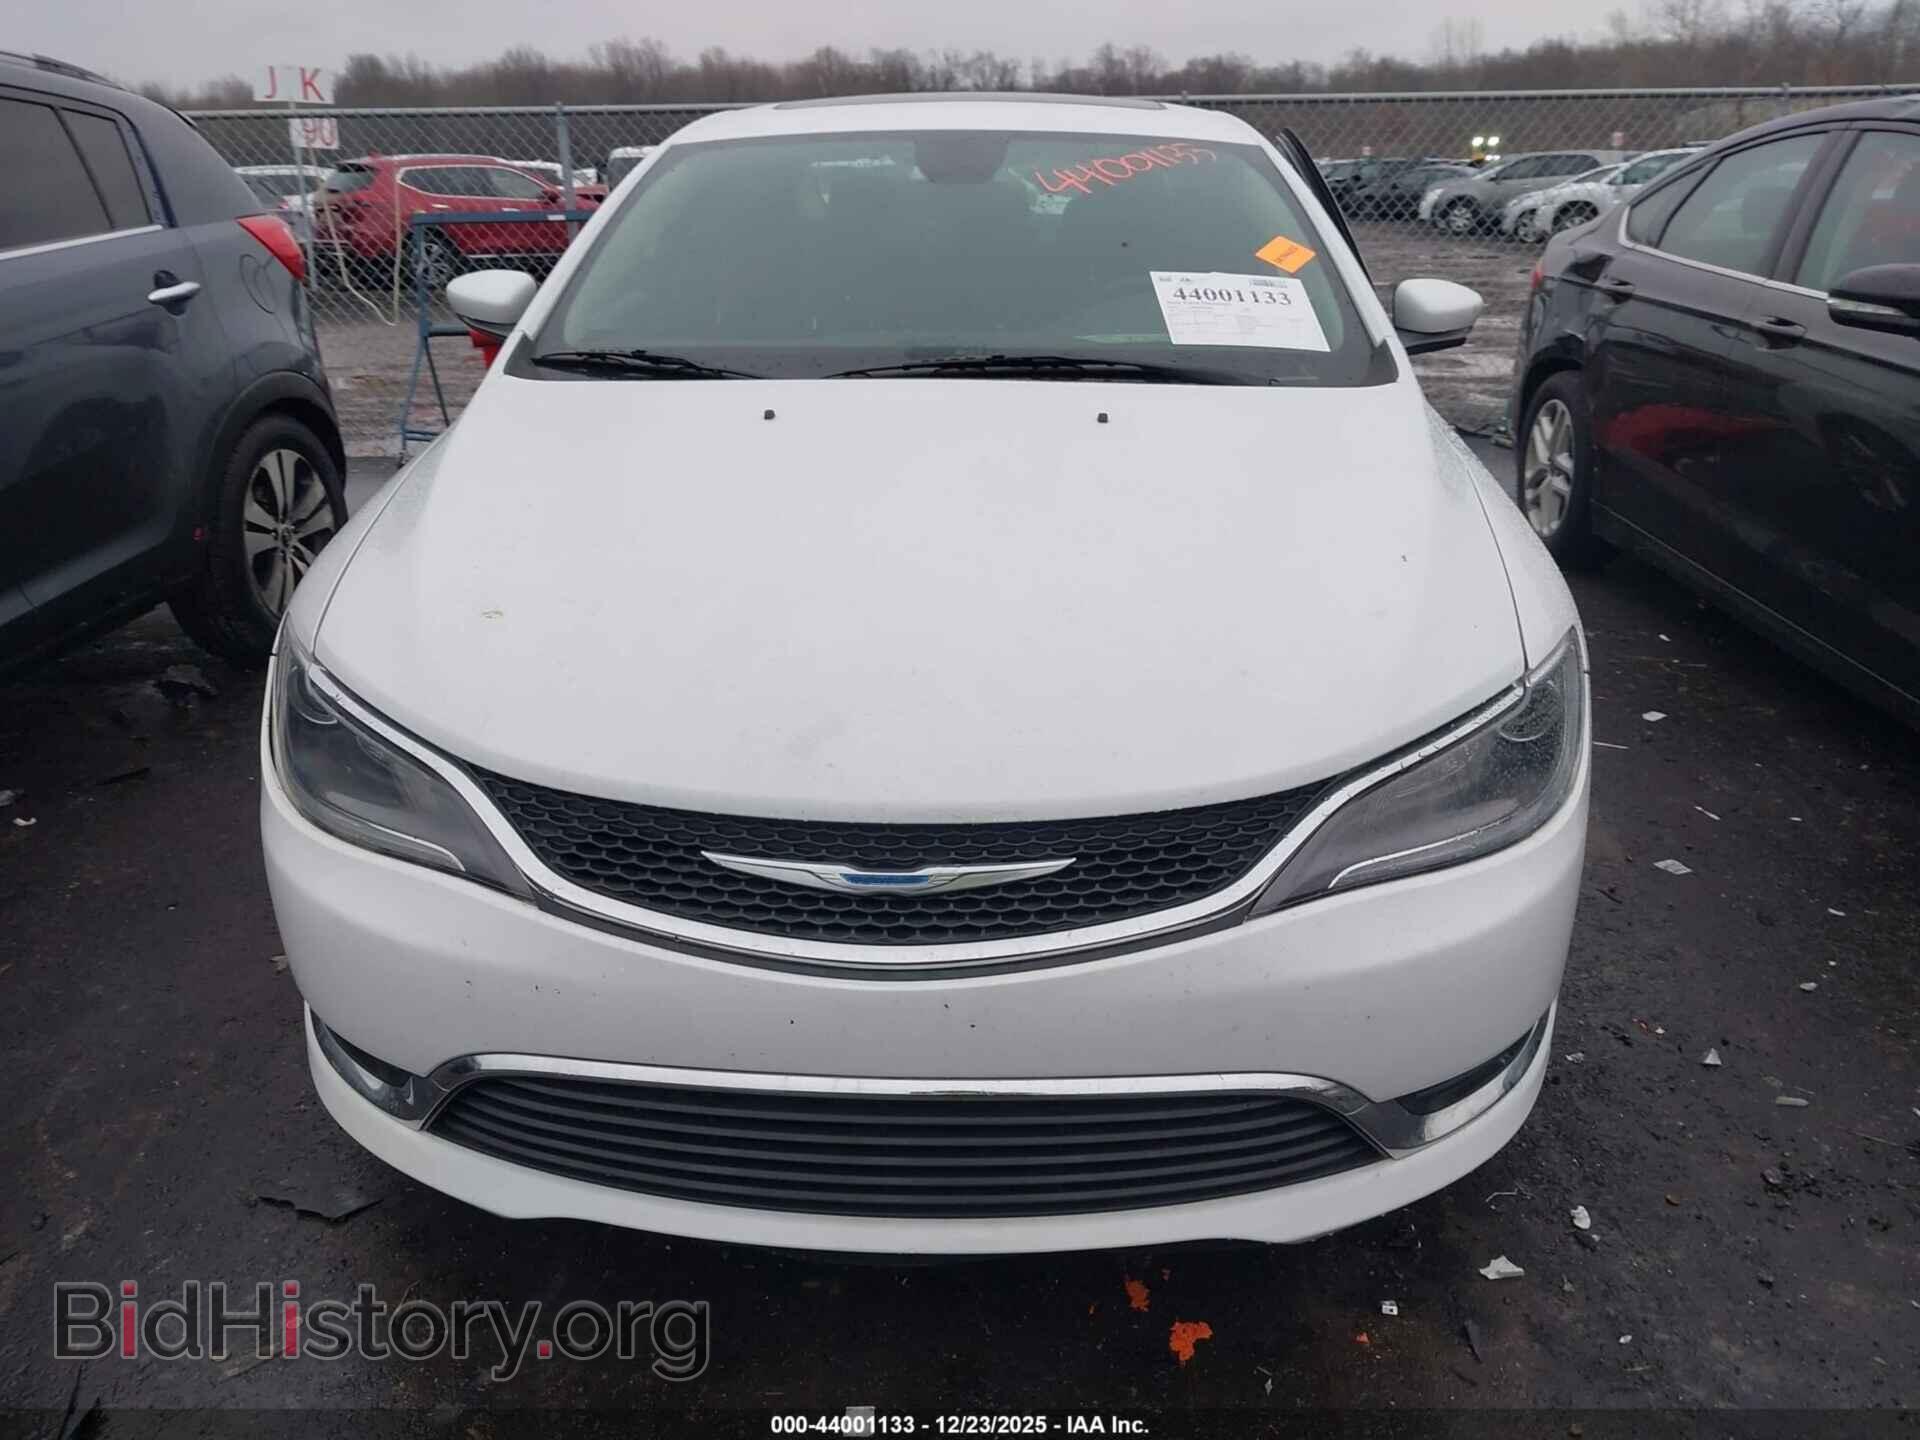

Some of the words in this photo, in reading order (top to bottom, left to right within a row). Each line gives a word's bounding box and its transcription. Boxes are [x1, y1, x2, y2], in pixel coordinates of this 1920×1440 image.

[264, 65, 278, 99] J
[299, 65, 325, 101] K
[1173, 287, 1293, 306] 44001133
